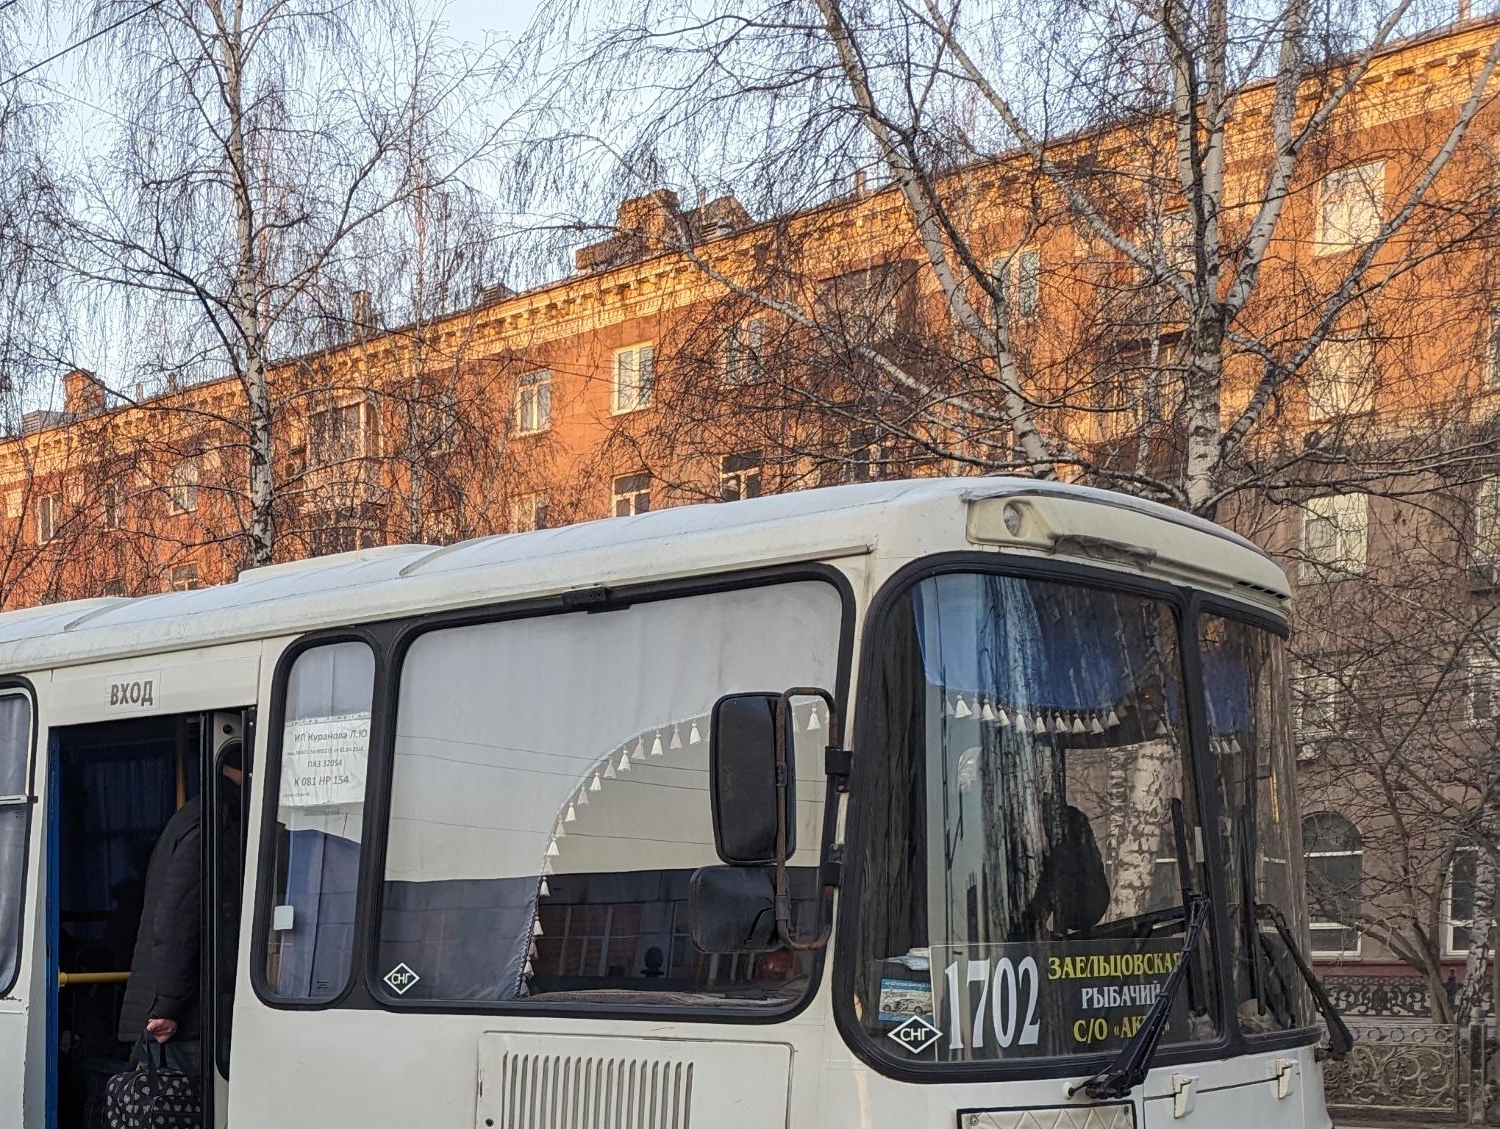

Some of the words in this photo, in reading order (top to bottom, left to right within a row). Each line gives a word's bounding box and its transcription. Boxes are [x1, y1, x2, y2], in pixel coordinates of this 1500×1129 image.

[110, 680, 153, 706] ВХОД
[294, 733, 306, 742] ИП
[308, 732, 347, 743] Куранова
[307, 760, 321, 768] ПАЗ
[322, 759, 342, 767] 32054
[293, 777, 300, 787] К
[301, 776, 316, 786] 081
[318, 775, 332, 785] НР
[333, 775, 349, 784] 154
[391, 973, 411, 985] СНГ
[1081, 980, 1161, 1010] РЫБАЧИЙ
[944, 956, 1041, 1050] 1702
[900, 1027, 930, 1042] СНГ
[1073, 1018, 1108, 1044] С/О
[1113, 1016, 1171, 1038] «АК»
